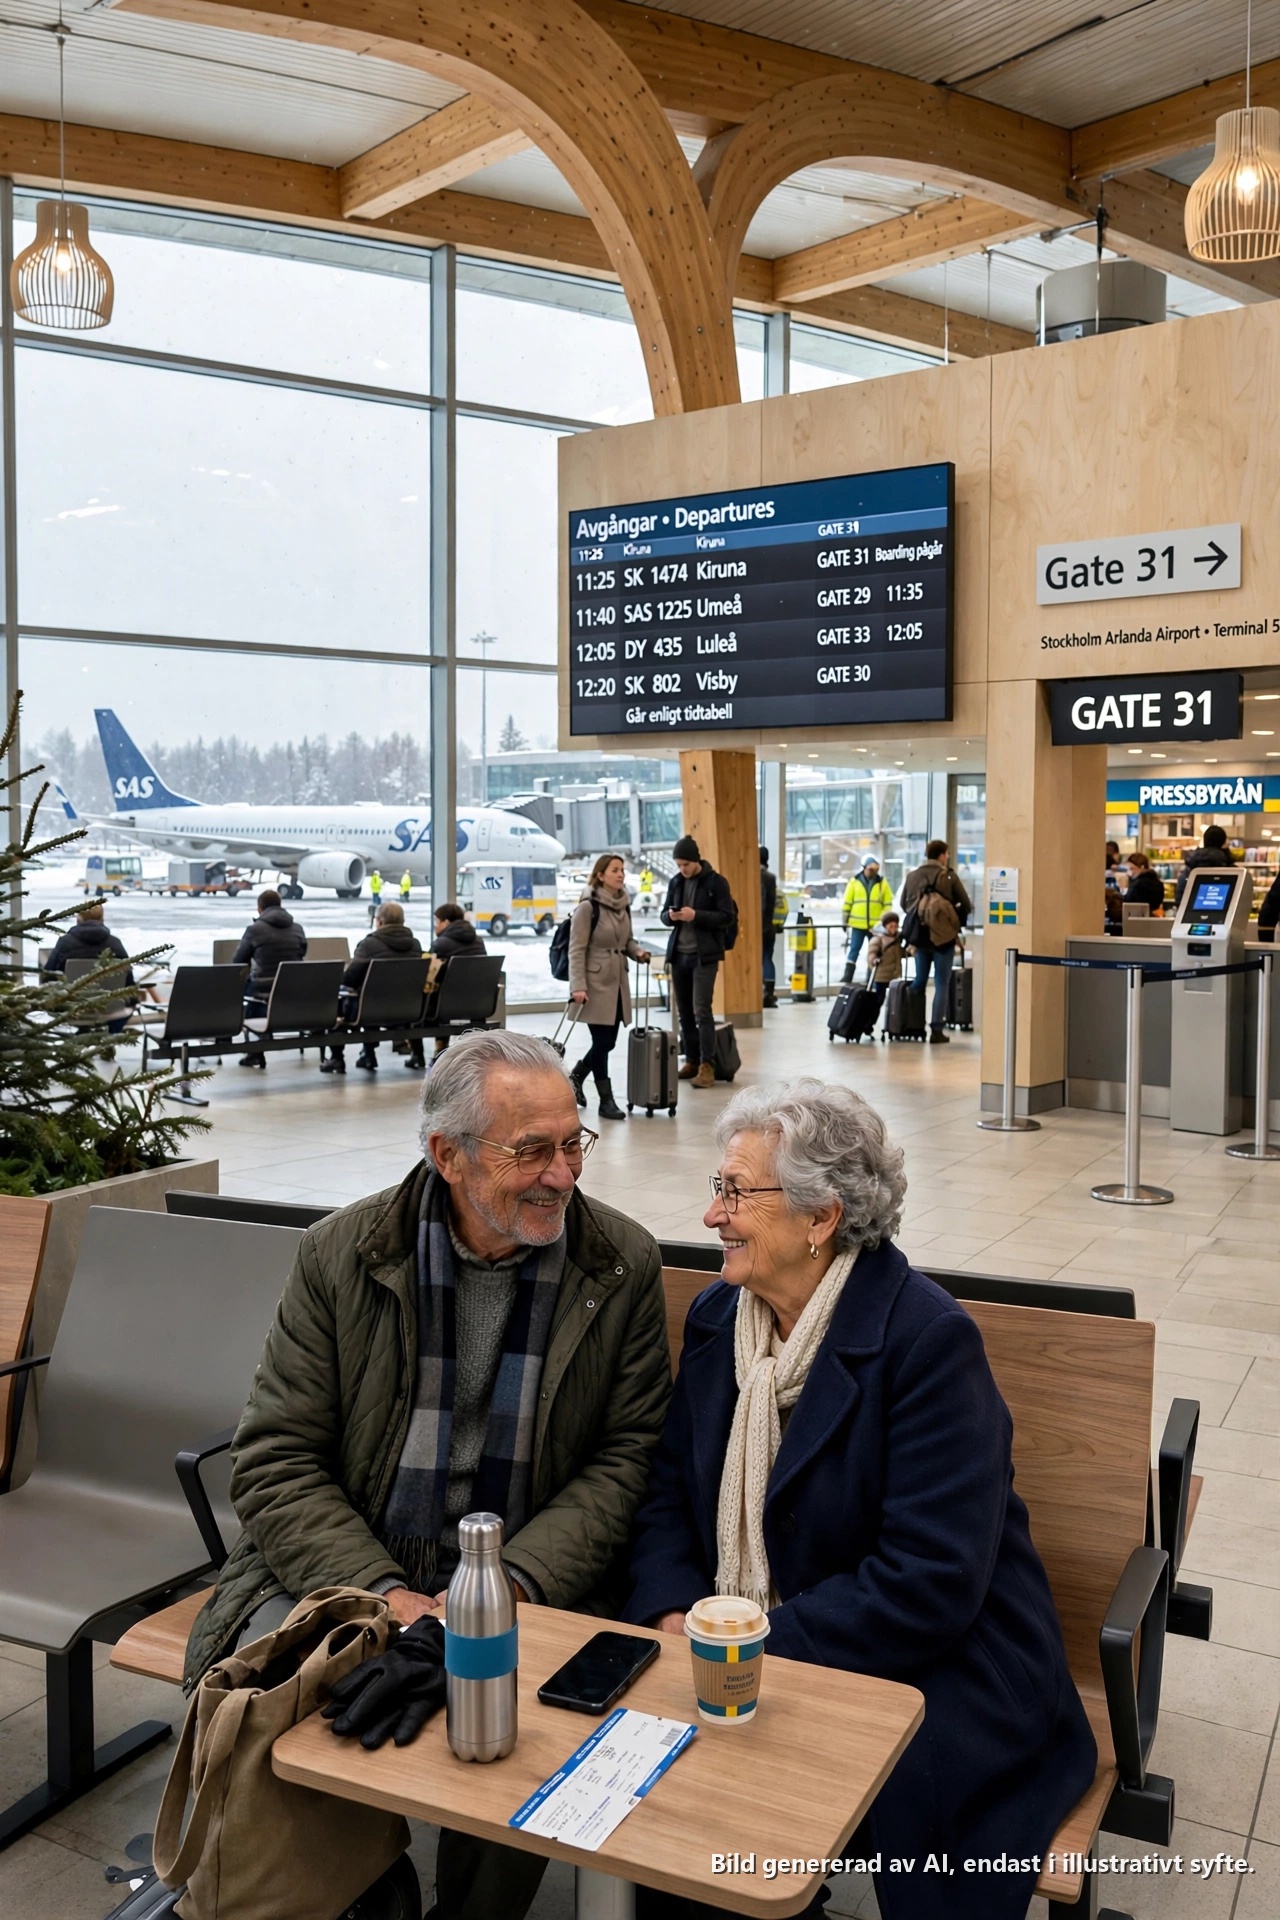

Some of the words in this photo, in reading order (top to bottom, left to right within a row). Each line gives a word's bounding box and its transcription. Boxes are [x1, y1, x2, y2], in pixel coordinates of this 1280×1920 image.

[576, 513, 658, 542] Avgångar
[675, 500, 775, 530] Departures
[818, 522, 844, 536] GATE
[576, 571, 615, 591] 11:25
[624, 567, 644, 587] SK
[651, 563, 688, 584] 1474
[697, 560, 747, 580] Kiruna
[817, 549, 850, 568] GATE
[854, 548, 869, 565] 31
[875, 545, 914, 562] Boarding
[916, 540, 943, 560] pågår
[1045, 555, 1125, 590] Gate
[1136, 545, 1175, 582] 31
[576, 606, 616, 627] 11:40
[624, 603, 652, 623] SAS
[657, 600, 692, 620] 1225
[697, 593, 742, 617] Umeå
[817, 588, 850, 607] GATE
[853, 586, 871, 605] 29
[887, 582, 923, 602] 11:35
[576, 642, 616, 662] 12:05
[625, 639, 647, 659] DY
[653, 637, 683, 657] 435
[697, 631, 737, 654] Luleå
[817, 627, 850, 646] GATE
[854, 626, 871, 643] 33
[887, 622, 923, 642] 12:05
[1040, 632, 1101, 650] Stockholm
[1105, 628, 1152, 645] Arlanda
[1155, 625, 1200, 644] Airport
[1213, 619, 1268, 638] Terminal
[1272, 618, 1280, 634] 5
[576, 677, 616, 697] 12:20
[624, 675, 645, 695] SK
[652, 673, 681, 694] 802
[696, 669, 738, 695] Visby
[817, 666, 850, 684] GATE
[853, 664, 871, 682] 30
[626, 706, 646, 724] Går
[649, 705, 682, 725] enligt
[684, 703, 733, 721] tidtabell
[1071, 692, 1162, 731] GATE
[1173, 690, 1212, 727] 31
[114, 776, 155, 799] SAS
[1139, 777, 1263, 807] PRESSBYRÅN
